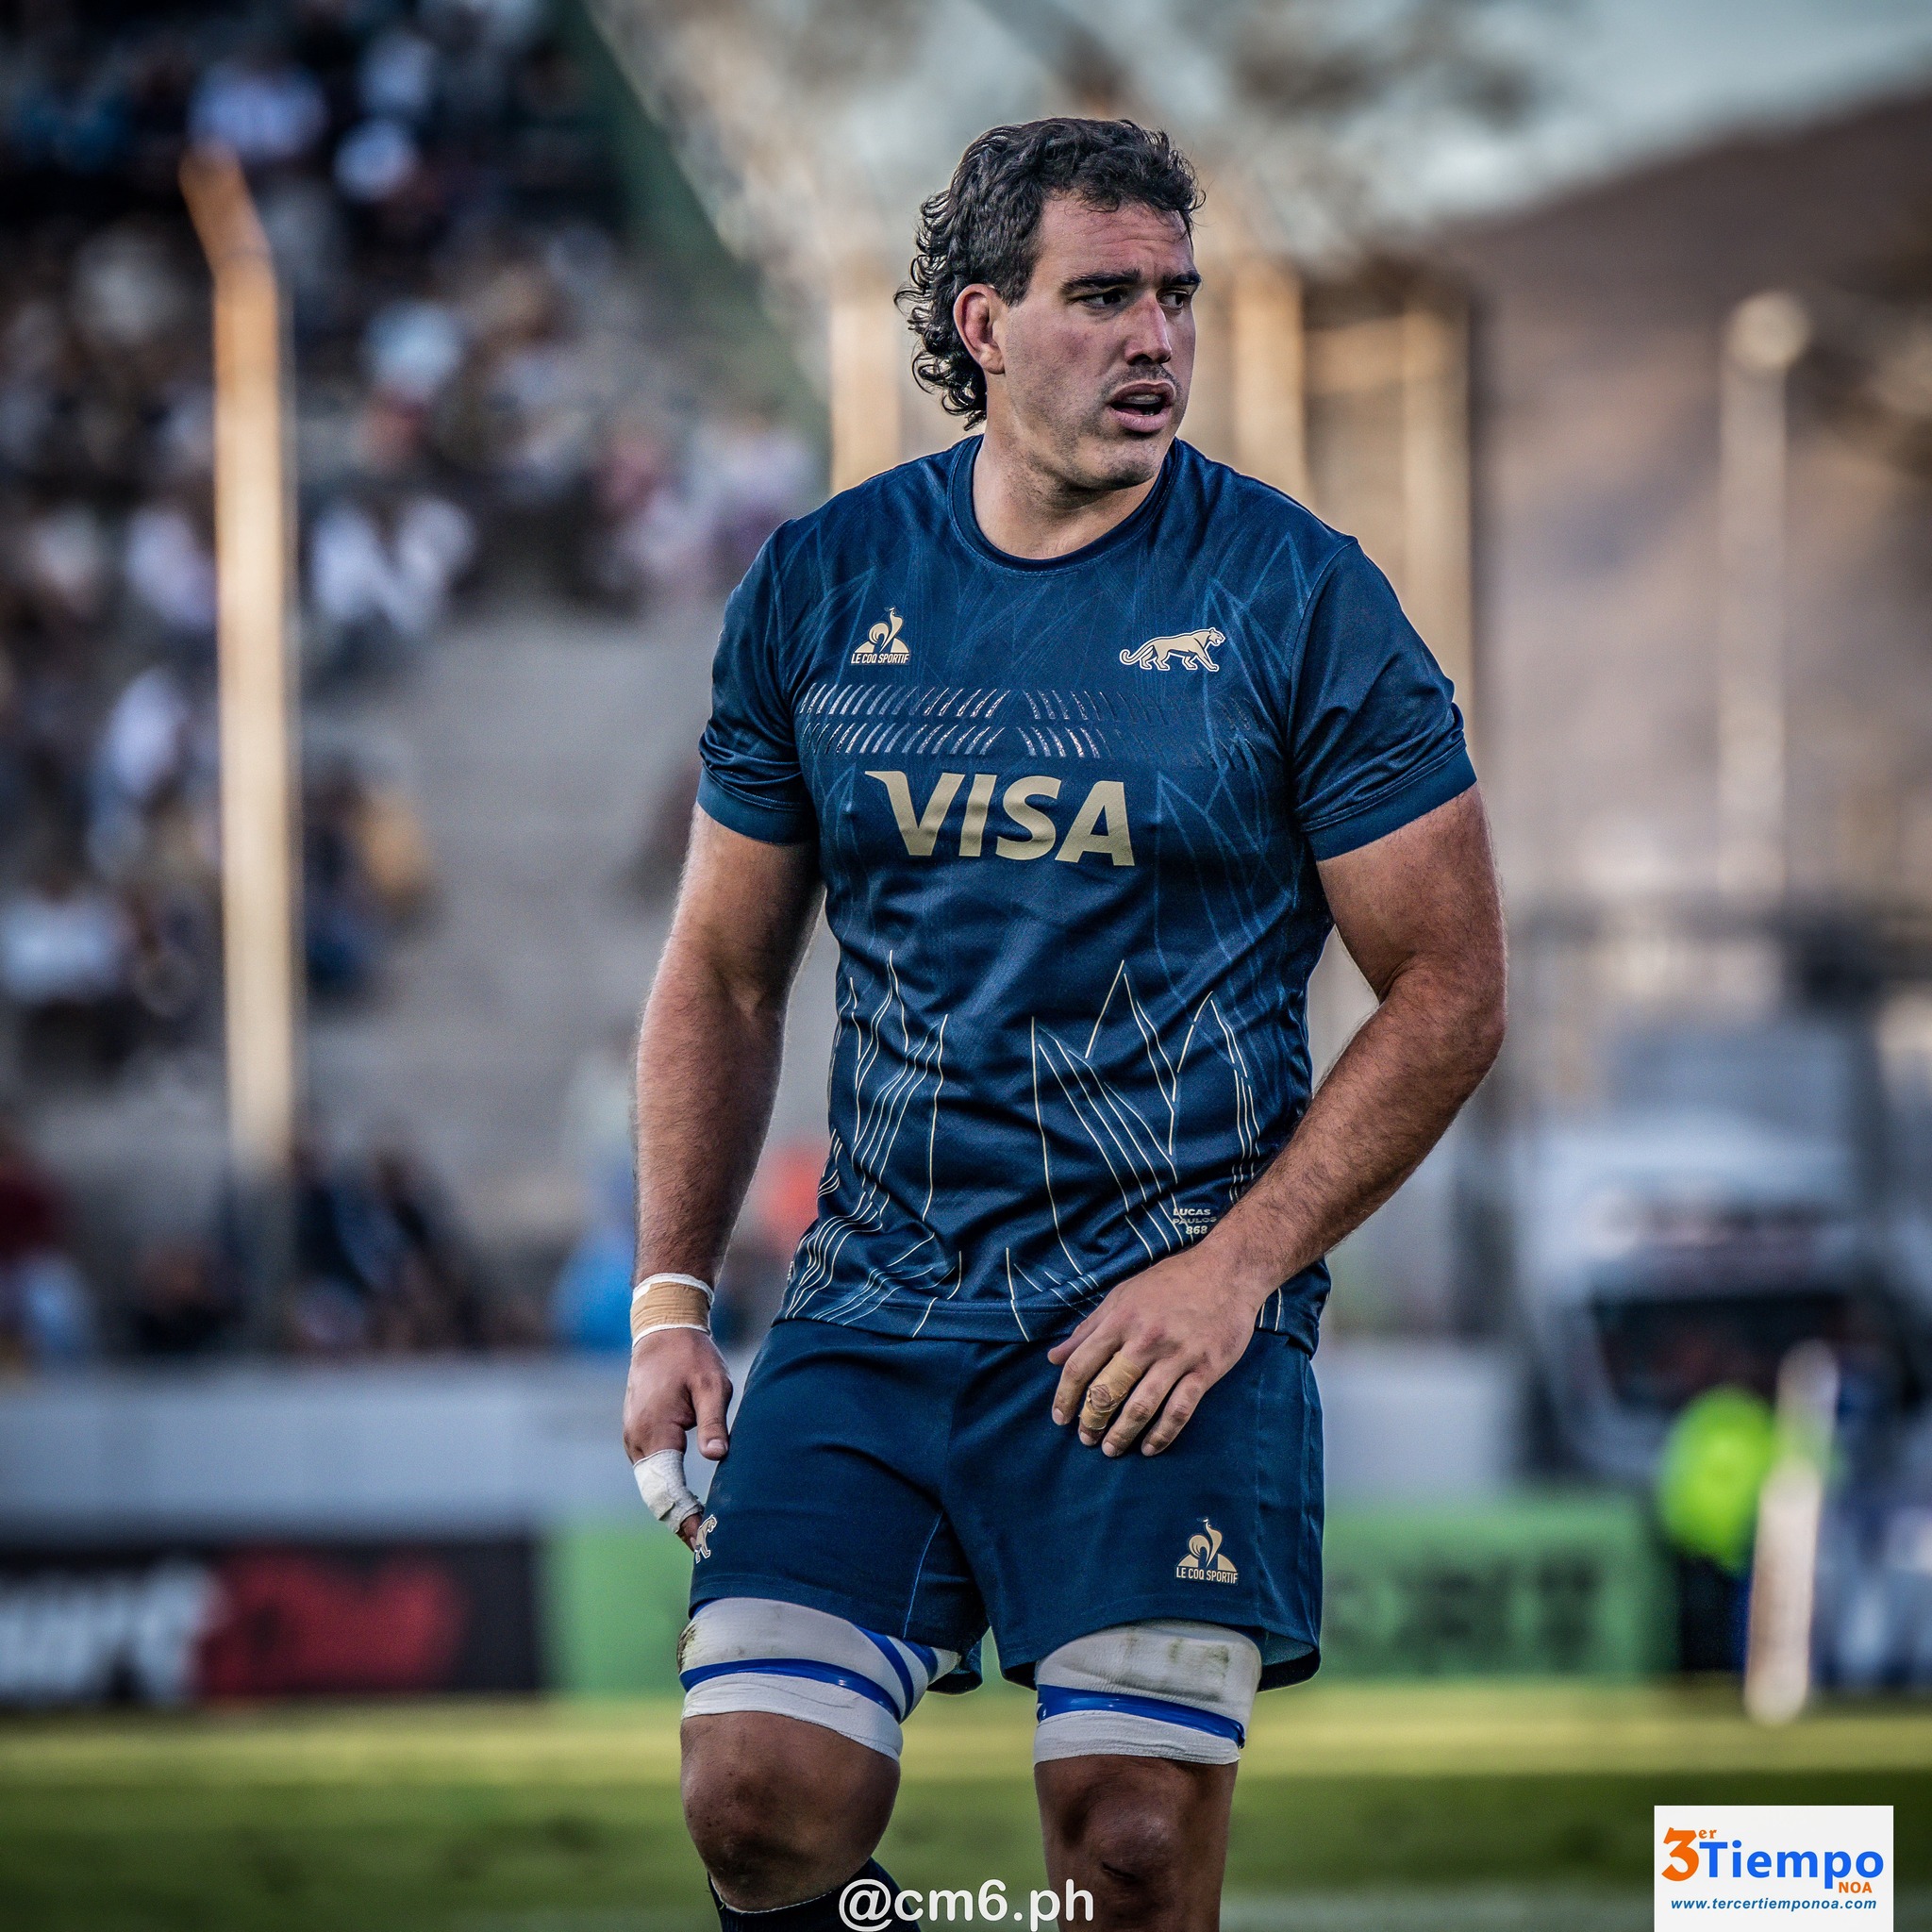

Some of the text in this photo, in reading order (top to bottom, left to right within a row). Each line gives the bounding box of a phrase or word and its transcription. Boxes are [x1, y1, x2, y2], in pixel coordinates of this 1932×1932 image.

[851, 653, 910, 664] LE COQ SPORTIF
[865, 770, 1135, 866] VISA
[1173, 1208, 1211, 1216] LUCAS
[1185, 1225, 1208, 1235] 868
[1176, 1567, 1239, 1584] LE COQ SPORTIF
